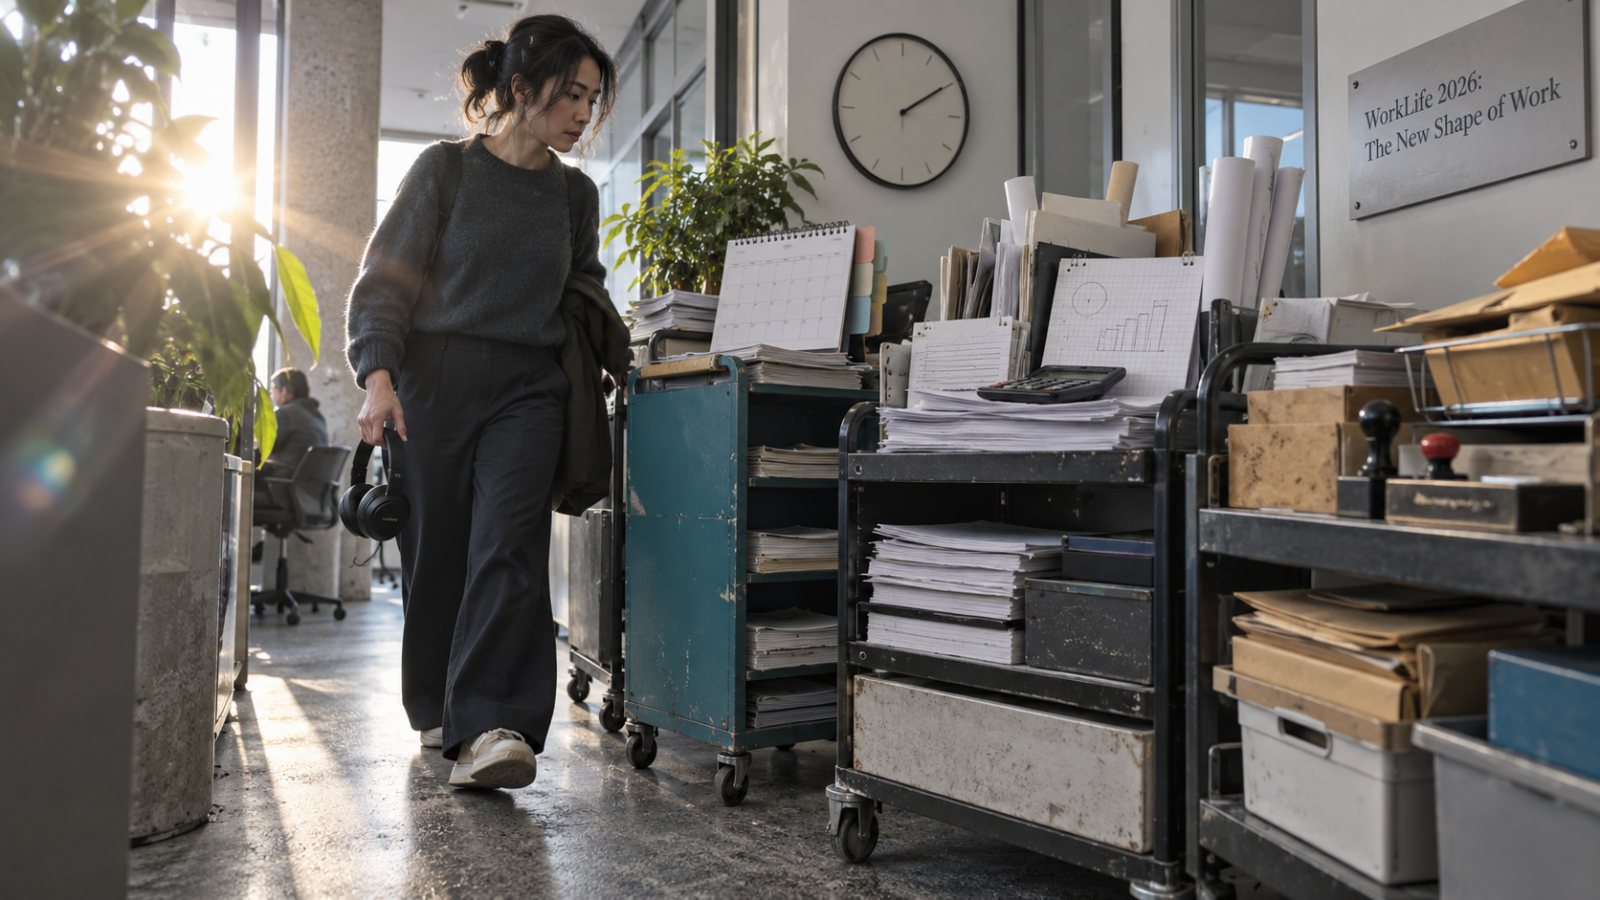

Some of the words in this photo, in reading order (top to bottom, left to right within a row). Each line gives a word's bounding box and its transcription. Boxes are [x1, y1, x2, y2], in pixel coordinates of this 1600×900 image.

[1364, 88, 1433, 130] WorkLife
[1437, 70, 1483, 105] 2026:
[1364, 138, 1392, 162] The
[1396, 127, 1429, 152] New
[1434, 109, 1482, 139] Shape
[1487, 95, 1506, 121] of
[1510, 77, 1562, 113] Work
